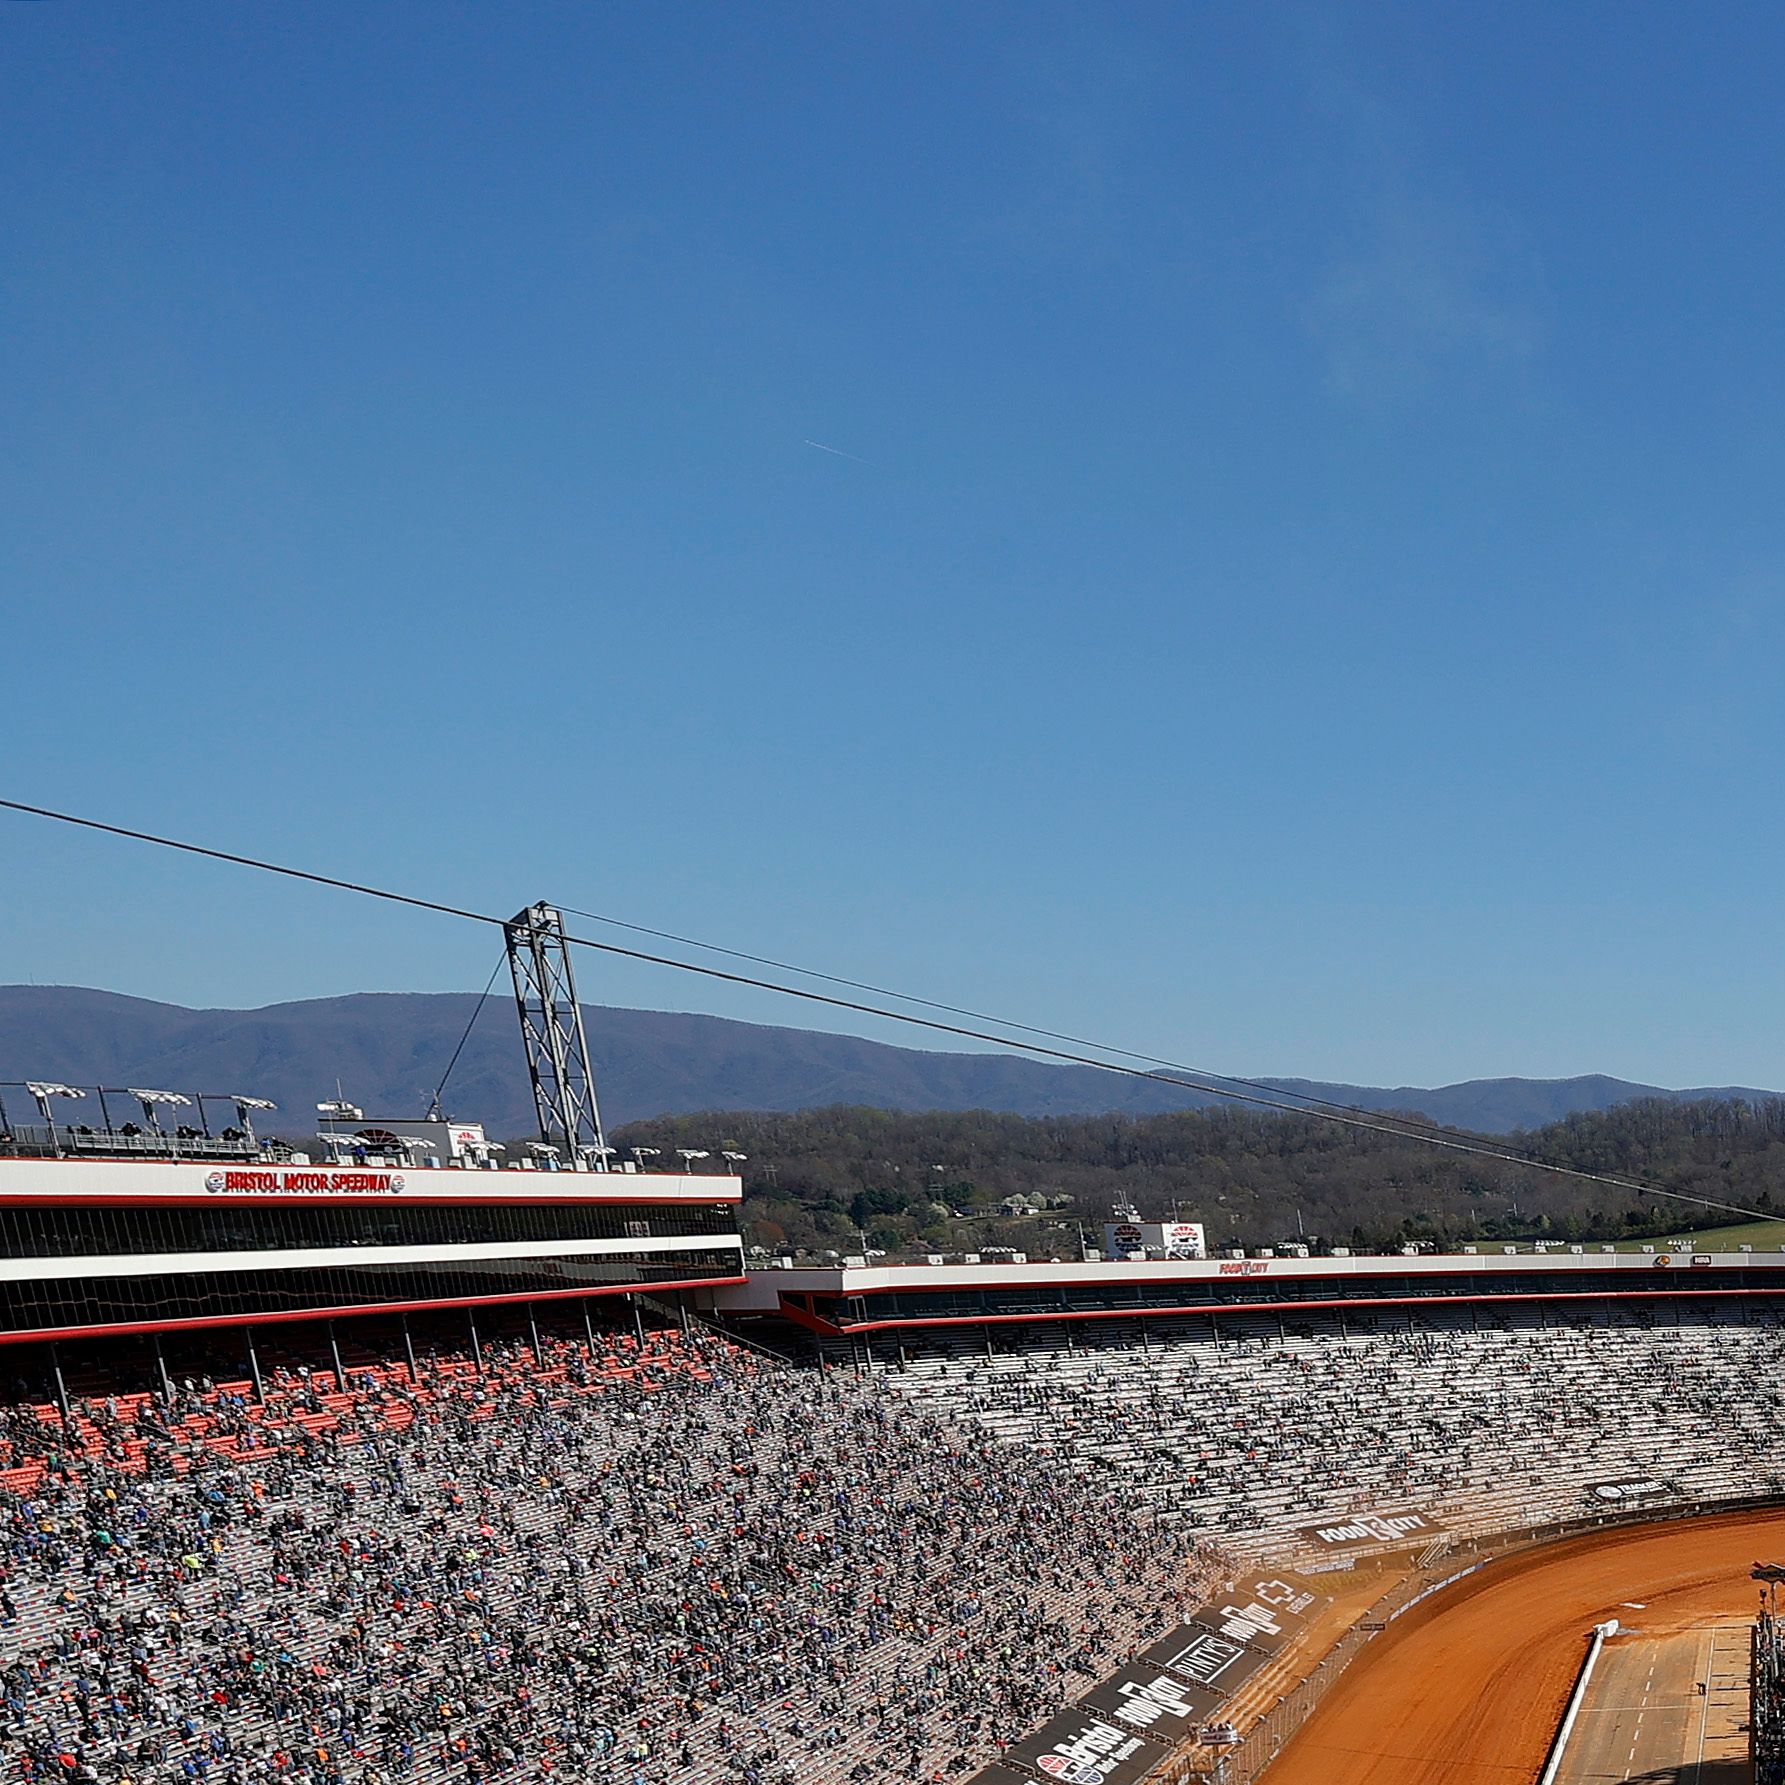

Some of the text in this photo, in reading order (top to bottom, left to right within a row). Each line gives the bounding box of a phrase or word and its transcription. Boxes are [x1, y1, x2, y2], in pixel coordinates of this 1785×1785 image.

[225, 1171, 392, 1192] BRISTOL MOTOR SPEEDWAY
[1316, 1515, 1428, 1543] FOOD CITY
[1179, 1639, 1236, 1677] PINTY'S
[1113, 1675, 1191, 1728] FOOD CITY
[1053, 1717, 1128, 1767] Bristol
